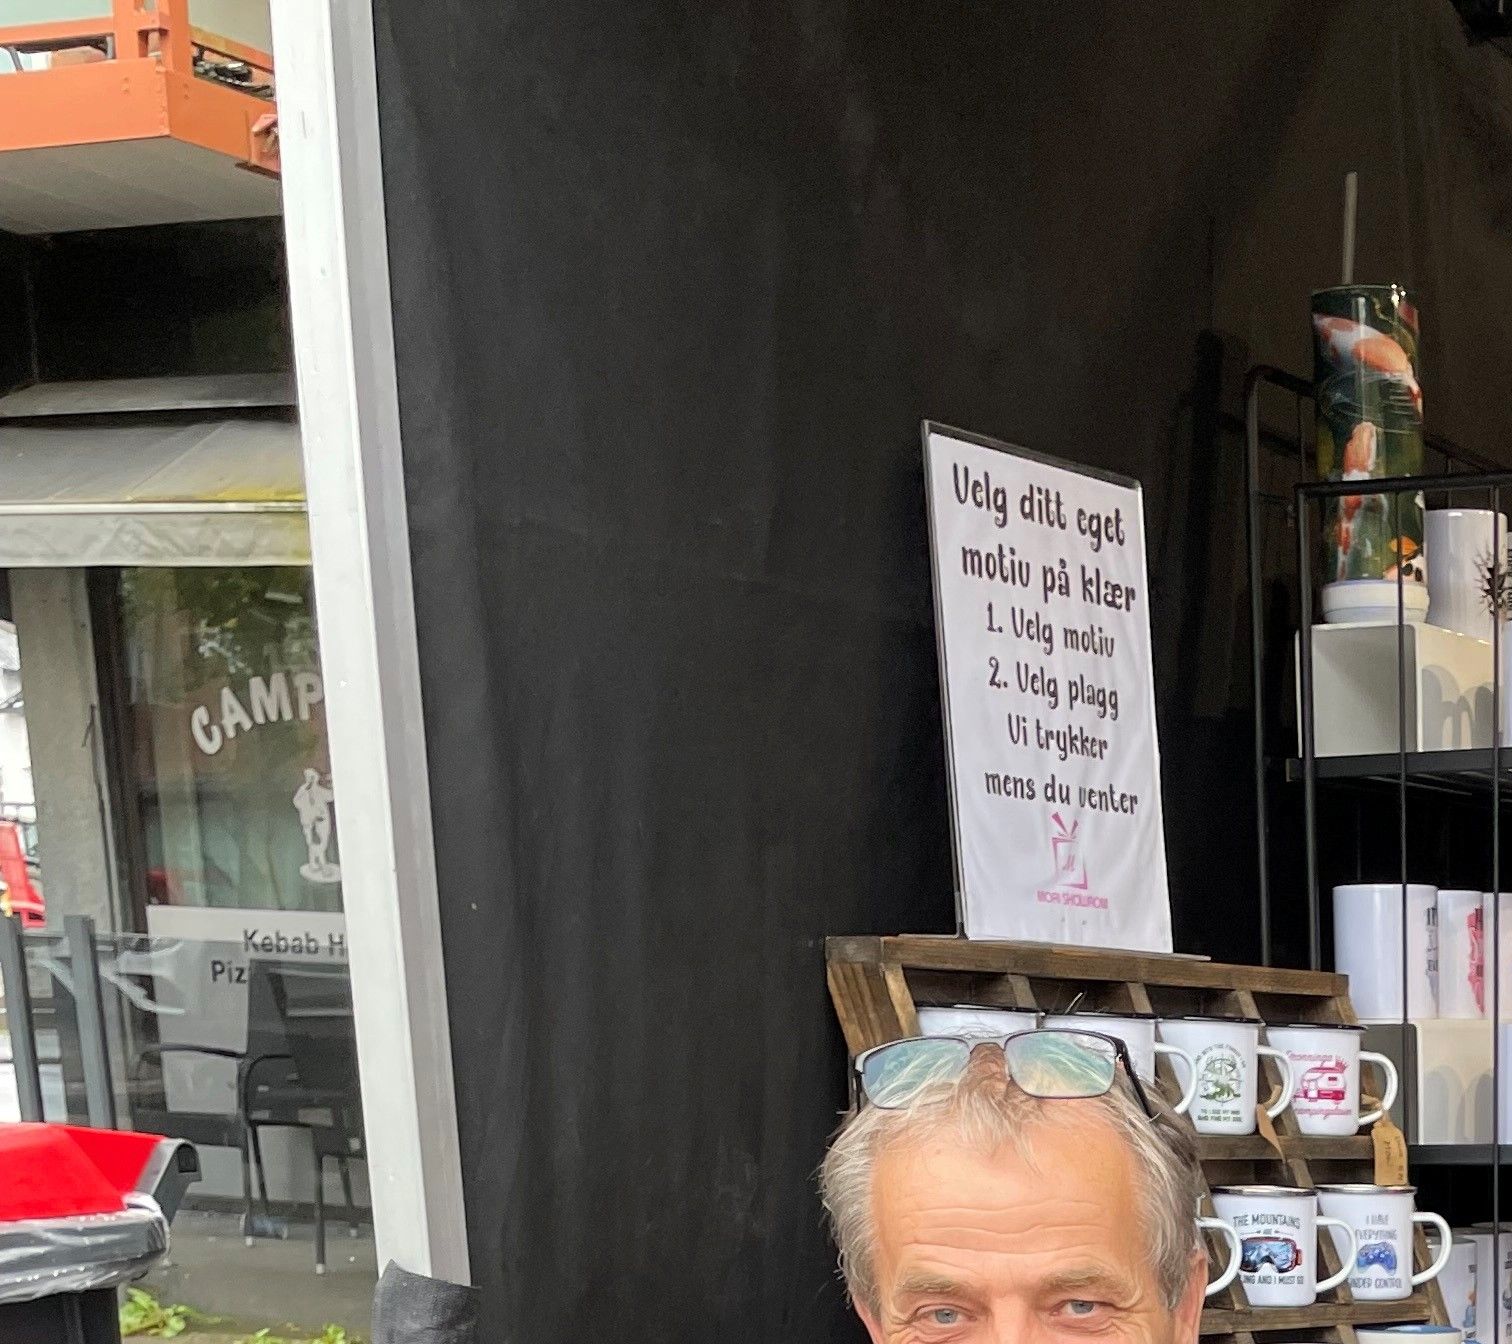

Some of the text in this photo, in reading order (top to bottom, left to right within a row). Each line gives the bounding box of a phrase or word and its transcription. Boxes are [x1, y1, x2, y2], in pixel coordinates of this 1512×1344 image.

[953, 462, 1125, 553] Velg ditt eget
[962, 544, 1136, 613] motiv på klær
[986, 602, 1115, 658] 1. Velg motiv
[191, 671, 324, 756] CAMP
[989, 656, 1119, 721] 2. Velg plagg
[1007, 713, 1108, 761] Vi trykker
[984, 770, 1139, 816] mens du venter
[242, 928, 319, 956] Kebab
